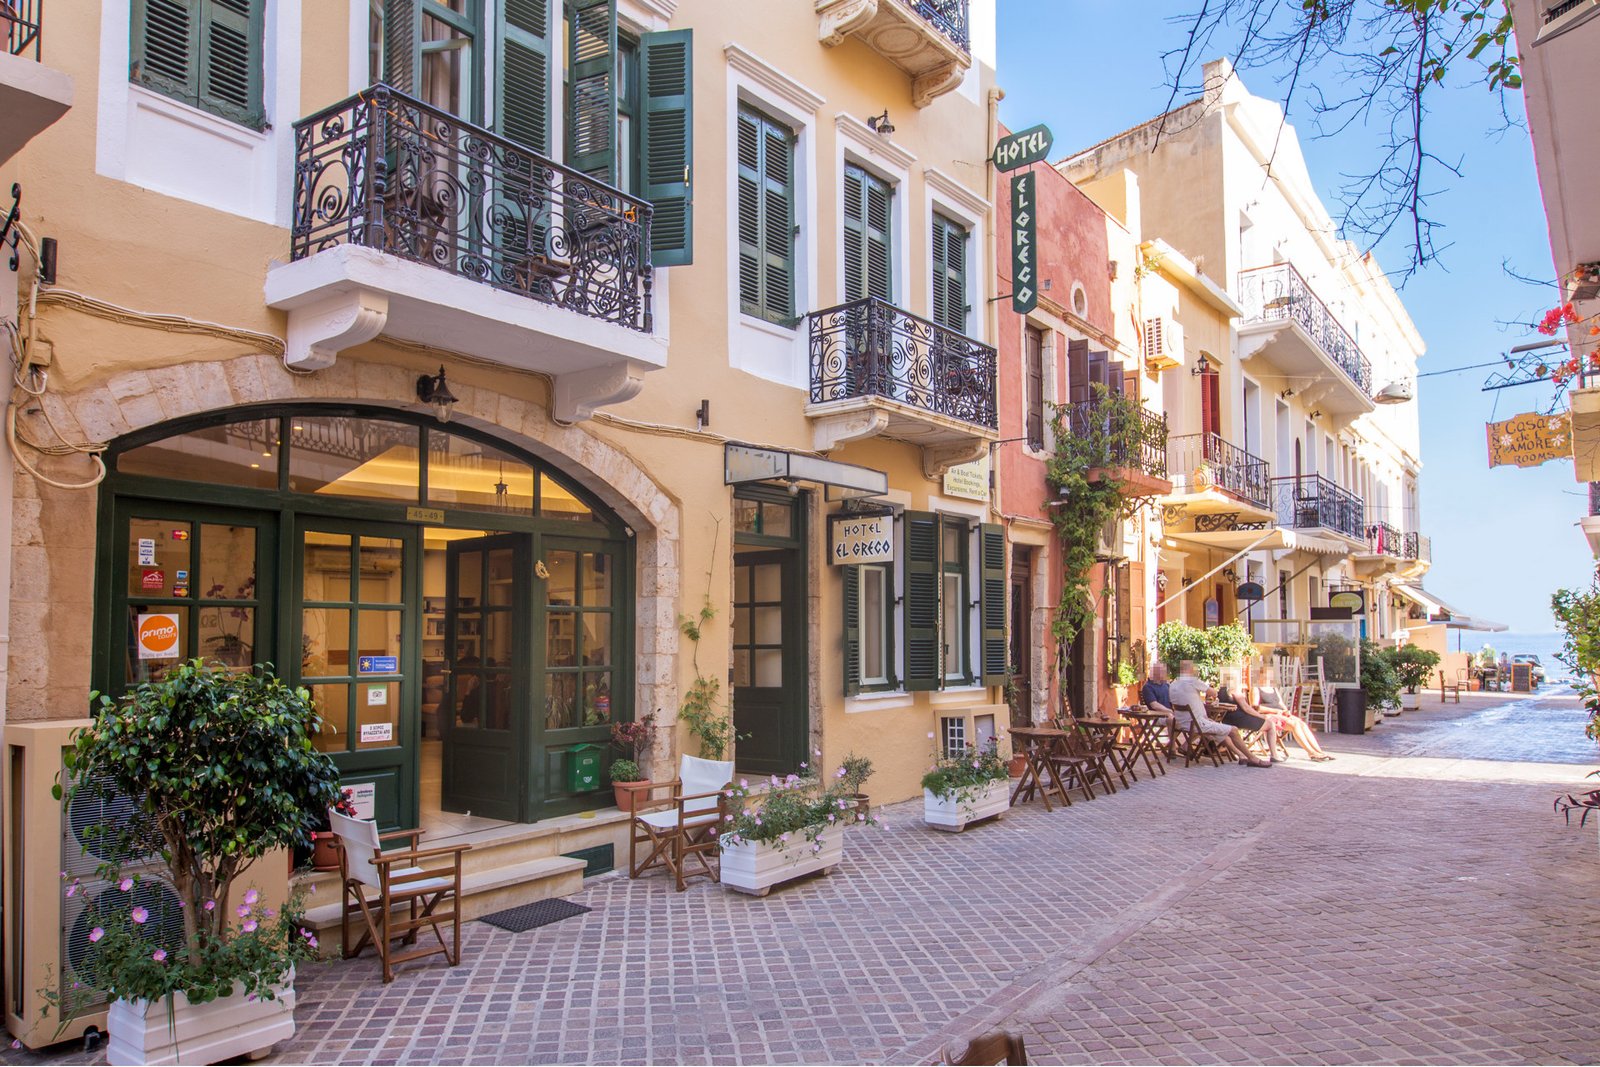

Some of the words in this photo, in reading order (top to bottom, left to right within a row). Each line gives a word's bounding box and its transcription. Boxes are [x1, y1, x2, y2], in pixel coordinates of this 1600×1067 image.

[996, 131, 1048, 165] HOTEL
[1505, 418, 1546, 434] Casa
[1507, 438, 1553, 454] AMORE
[1514, 453, 1555, 463] ROOMS
[844, 523, 881, 538] HOTEL
[836, 543, 849, 558] EL
[852, 540, 890, 556] GRECO
[141, 626, 174, 641] primo
